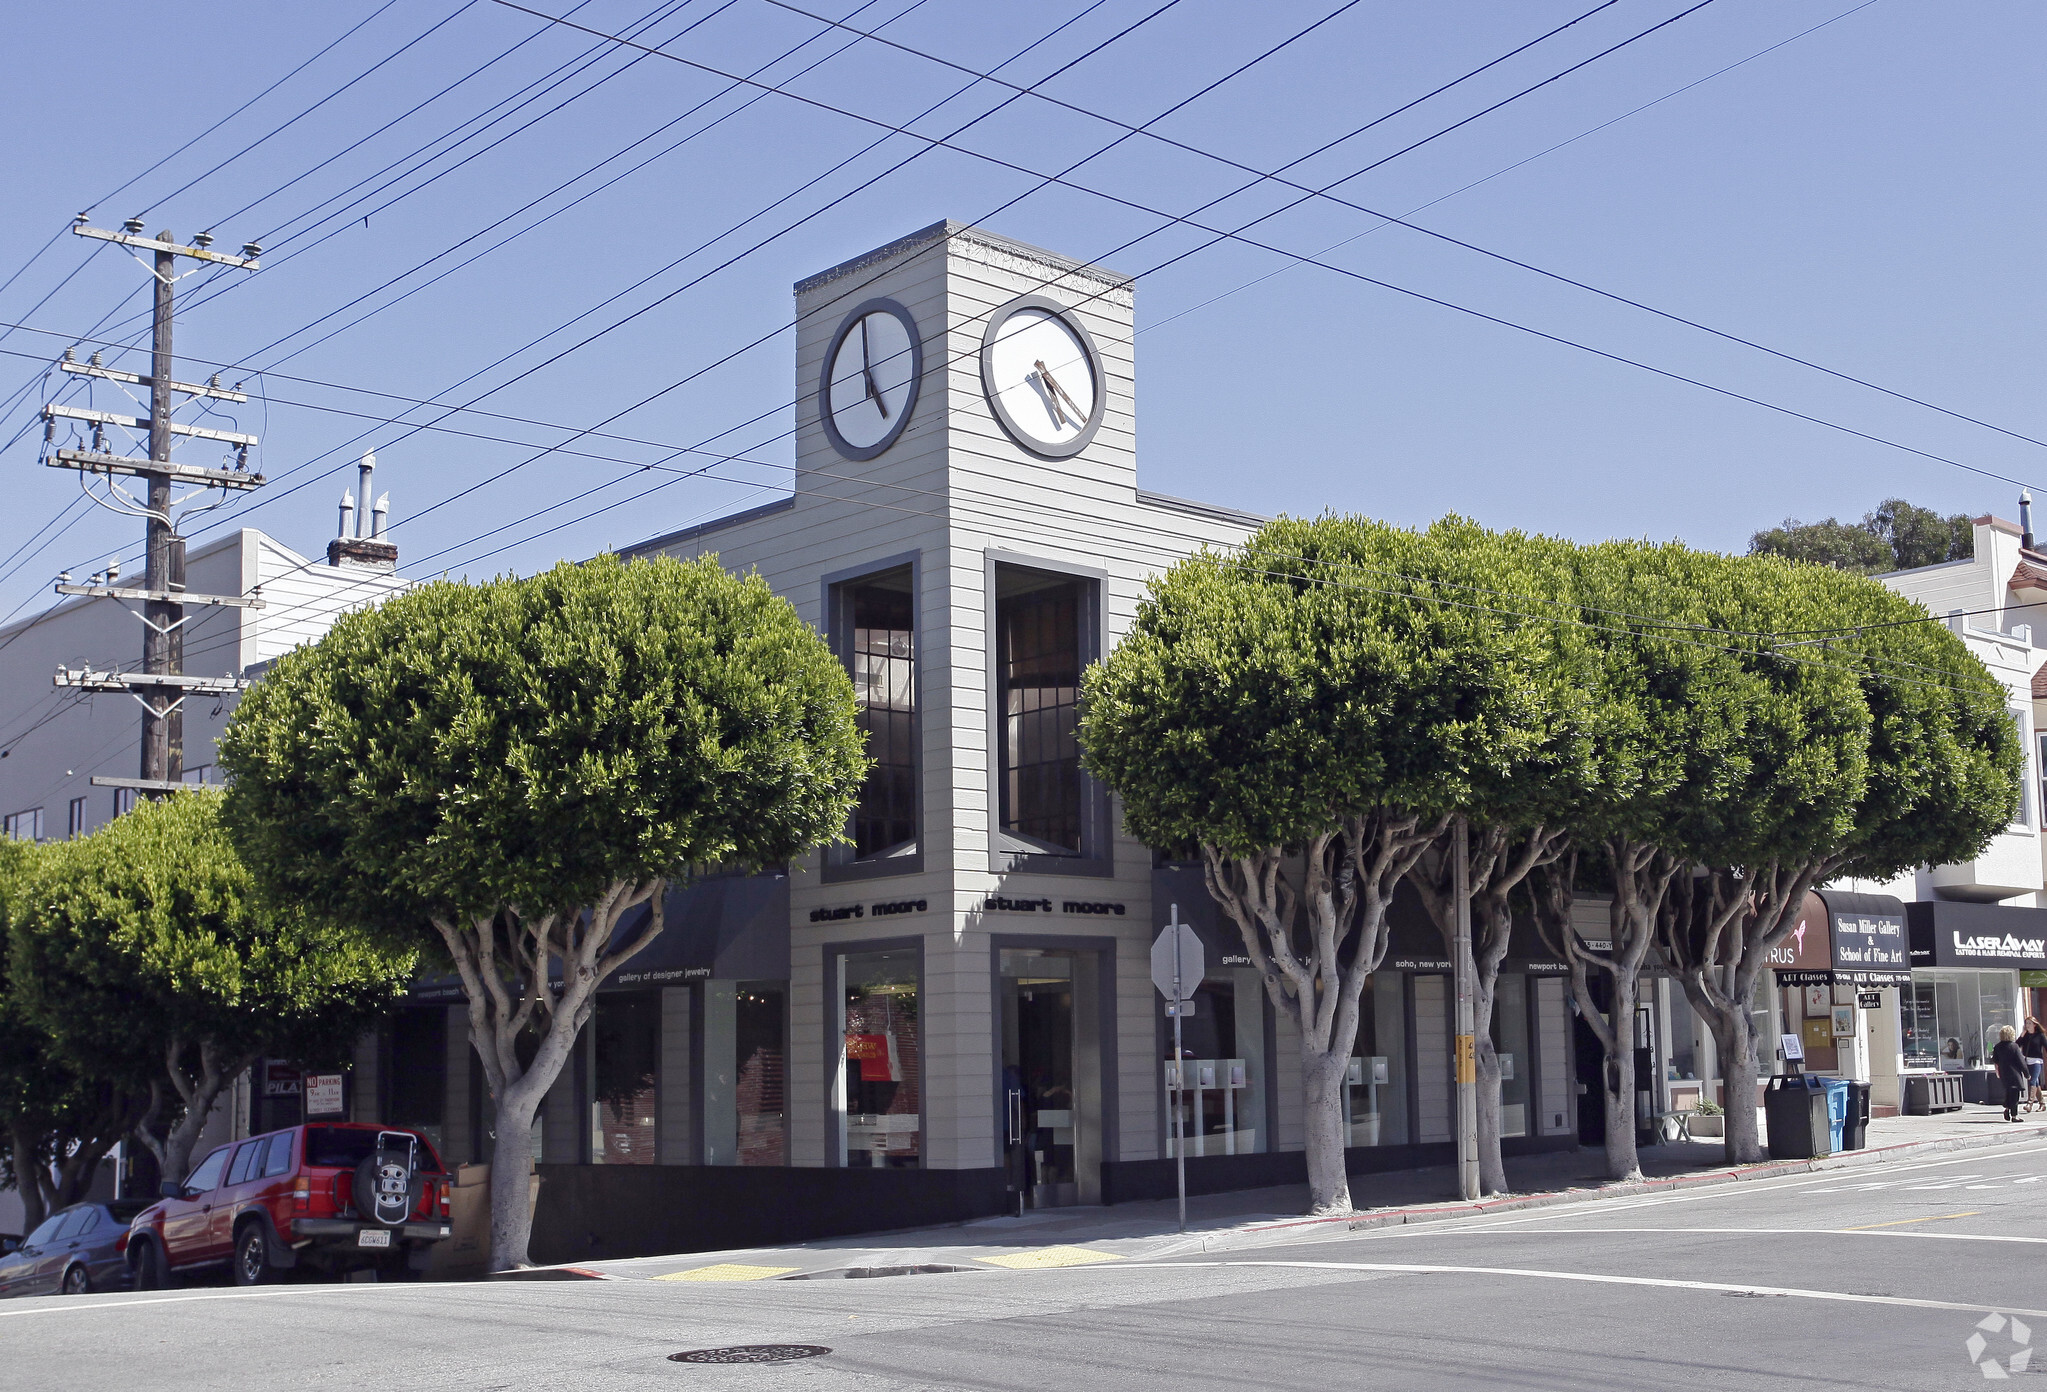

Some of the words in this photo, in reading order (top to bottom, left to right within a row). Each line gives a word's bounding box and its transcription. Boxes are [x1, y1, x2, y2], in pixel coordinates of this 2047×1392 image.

[809, 903, 864, 923] stuart
[871, 898, 928, 917] moore
[984, 897, 1052, 913] stuart
[1063, 900, 1126, 916] moore
[1837, 917, 1858, 933] Susan
[1858, 919, 1877, 934] Miller
[1878, 920, 1901, 938] Gallery
[1867, 935, 1875, 946] &
[1840, 946, 1862, 962] School
[1863, 947, 1871, 962] of
[1873, 948, 1889, 962] Fine
[1890, 949, 1903, 963] Art
[1954, 948, 1977, 956] TATTOO
[1982, 949, 1996, 957] HAIR
[1997, 950, 2022, 958] REMOVAL
[2022, 951, 2046, 959] EXPERTS
[1222, 955, 1251, 965] gallery
[1528, 962, 1557, 971] newport
[618, 972, 641, 983] gallery
[643, 971, 651, 980] of
[653, 970, 682, 980] designer
[684, 967, 711, 978] jewelry
[1782, 974, 1798, 982] ART
[1799, 973, 1828, 981] Classes
[1853, 973, 1867, 982] ART
[1869, 972, 1894, 982] Classes
[307, 1076, 317, 1087] NO
[319, 1077, 341, 1086] PARKING
